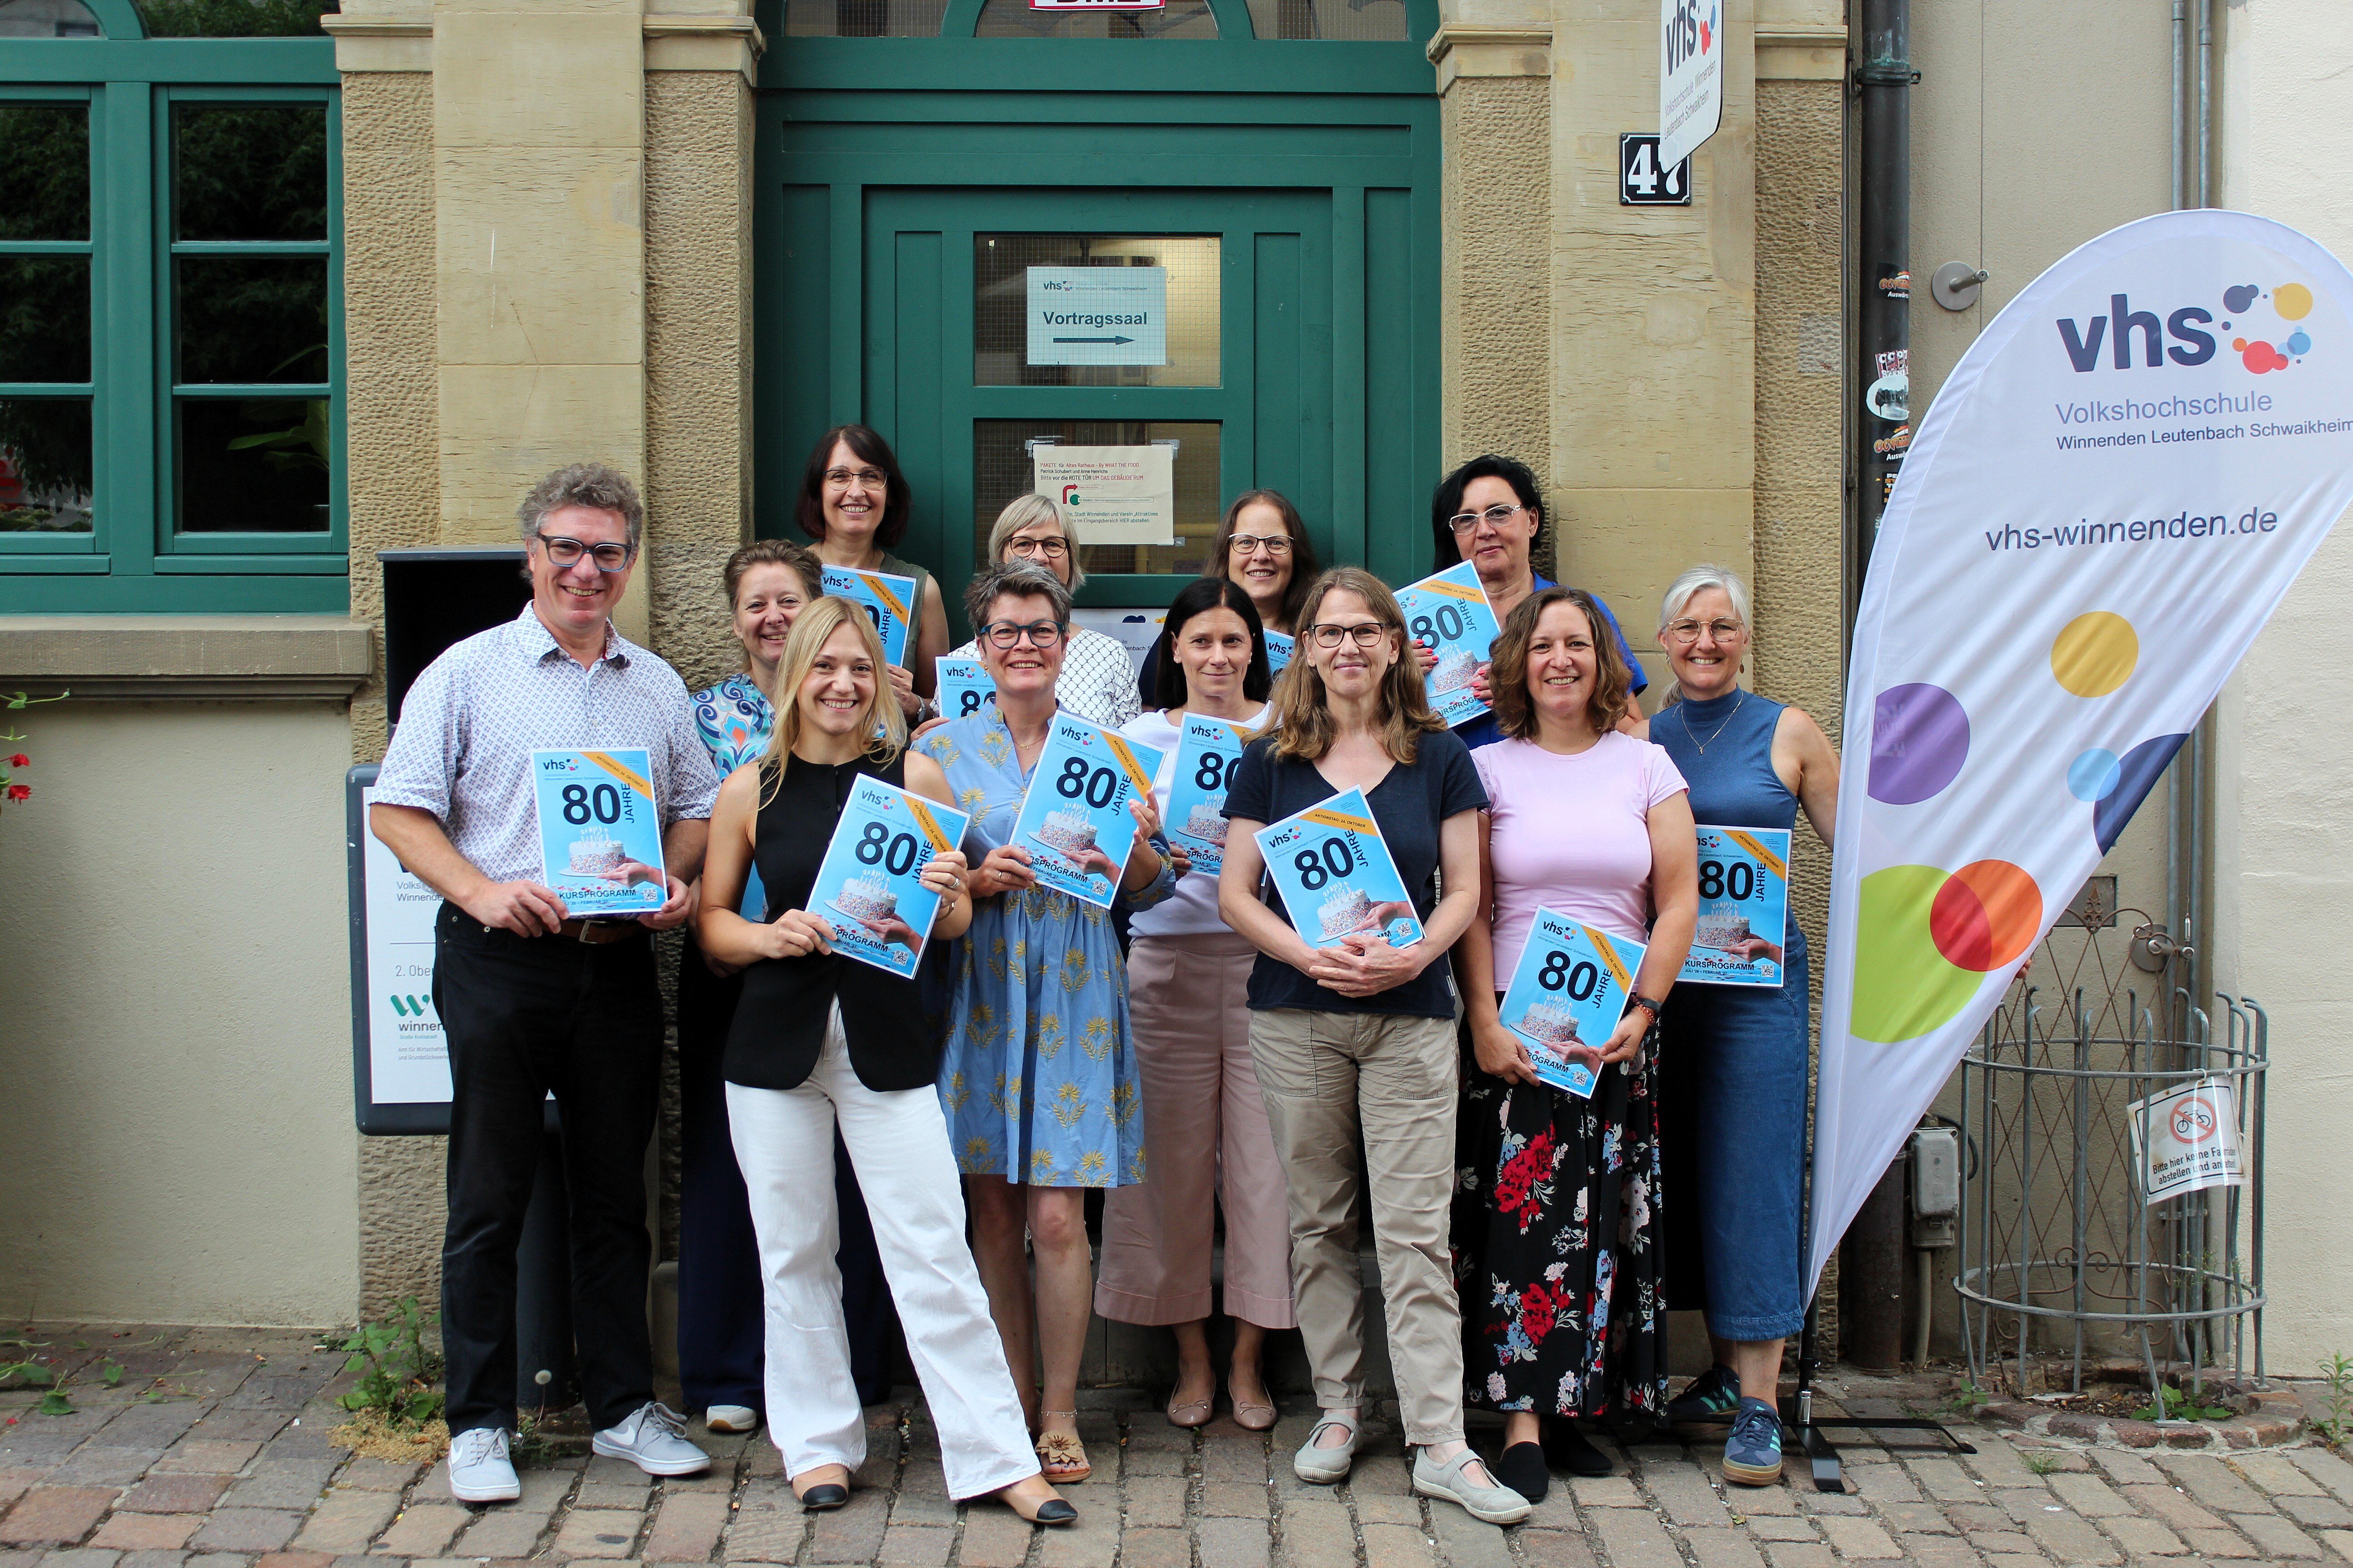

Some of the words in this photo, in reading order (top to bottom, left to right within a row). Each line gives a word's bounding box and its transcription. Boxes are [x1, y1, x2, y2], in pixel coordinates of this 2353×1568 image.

[1666, 0, 1696, 76] vhs
[1665, 80, 1693, 117] Volkshochschule
[1695, 60, 1716, 89] Winnenden
[1664, 115, 1685, 140] Leutenbach
[1685, 89, 1709, 121] Schwaikheim
[1044, 281, 1062, 290] vhs
[1043, 312, 1147, 328] Vortragssaal
[2056, 293, 2216, 372] vhs
[2055, 390, 2272, 425] Volkshochschule
[2056, 431, 2145, 450] Winnenden
[2152, 424, 2244, 444] Leutenbach
[2249, 418, 2353, 438] Schwaikheim
[1986, 507, 2278, 552] vhs-winnenden.de
[823, 575, 842, 587] vhs
[890, 601, 903, 614] OKTOBER
[881, 607, 892, 644] JAHRE
[1410, 605, 1463, 649] 80
[1456, 597, 1477, 631] JAHRE
[1269, 642, 1287, 654] vhs
[946, 667, 965, 677] vhs
[1061, 727, 1081, 741] vhs
[1191, 725, 1211, 737] vhs
[543, 759, 565, 770] vhs
[626, 775, 643, 787] OKTOBER
[1132, 769, 1144, 786] OKTOBER
[1056, 757, 1117, 808] 80
[1111, 774, 1132, 816] JAHRE
[562, 784, 621, 825] 80
[621, 783, 634, 824] JAHRE
[862, 790, 882, 805] vhs
[855, 821, 918, 876] 80
[934, 834, 946, 852] OKTOBER
[1269, 833, 1290, 848] vhs
[1294, 837, 1354, 891] 80
[1344, 828, 1368, 867] JAHRE
[1764, 855, 1779, 868] OKTOBER
[1698, 860, 1754, 901] 80
[1756, 863, 1766, 901] JAHRE
[559, 889, 636, 899] KURSPROGRAMM
[1543, 921, 1563, 935] vhs
[395, 965, 406, 976] 2.
[1612, 963, 1625, 980] OKTOBER
[1685, 961, 1754, 971] KURSPROGRAMM
[1538, 950, 1598, 1001] 80
[1592, 968, 1613, 1008] JAHRE
[2153, 1162, 2168, 1174] Bitte
[2169, 1156, 2183, 1168] hier
[2185, 1150, 2208, 1163] keine
[2159, 1167, 2190, 1185] abstellen
[2193, 1161, 2209, 1173] und
